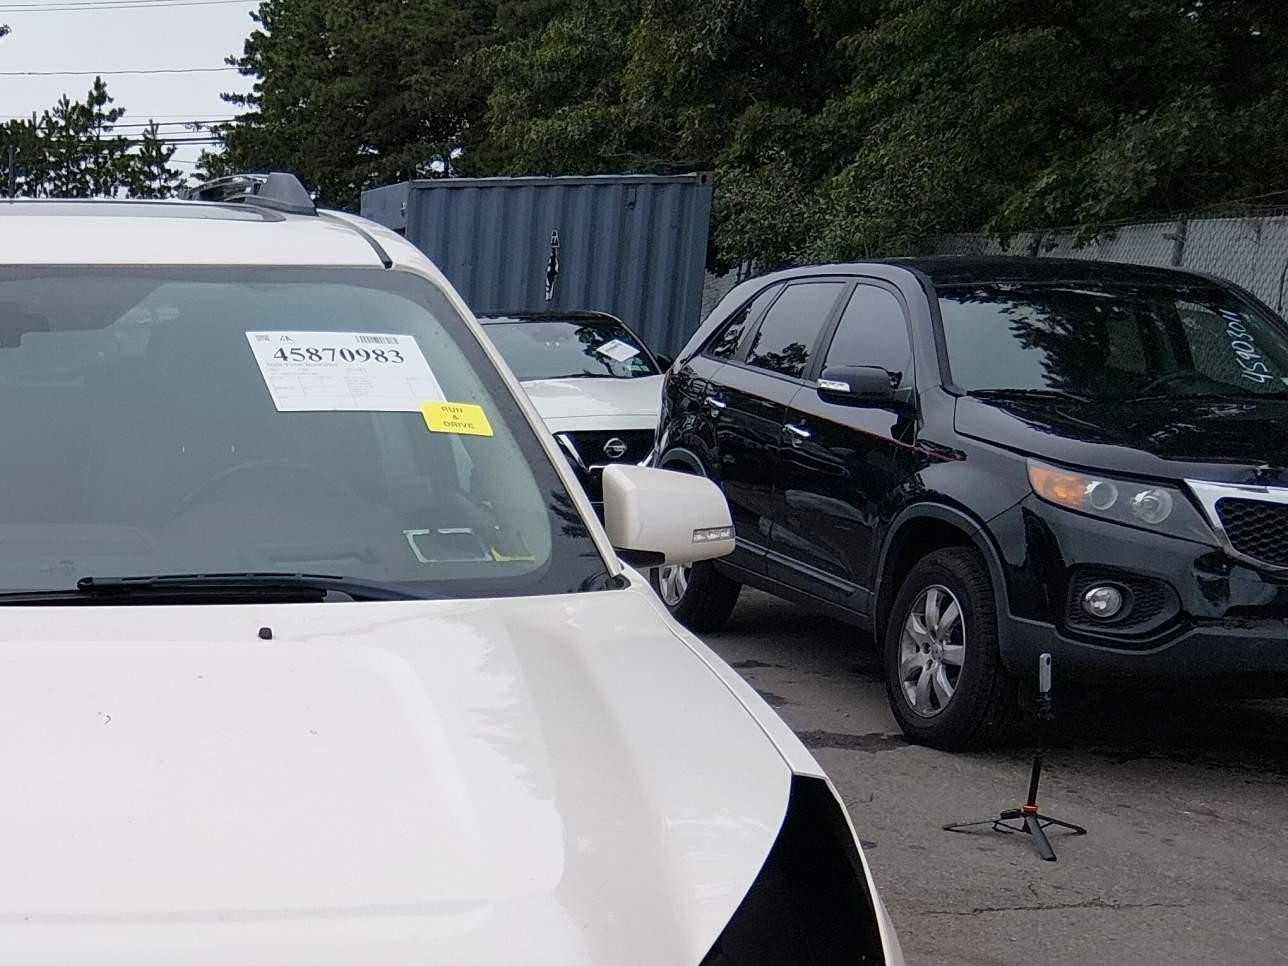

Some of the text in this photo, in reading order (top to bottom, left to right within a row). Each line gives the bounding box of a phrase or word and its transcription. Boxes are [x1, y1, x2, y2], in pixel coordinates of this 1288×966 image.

[1218, 308, 1274, 383] 45903011
[273, 346, 405, 364] 45870983
[441, 406, 464, 414] RUN
[443, 421, 476, 430] DRIVE
